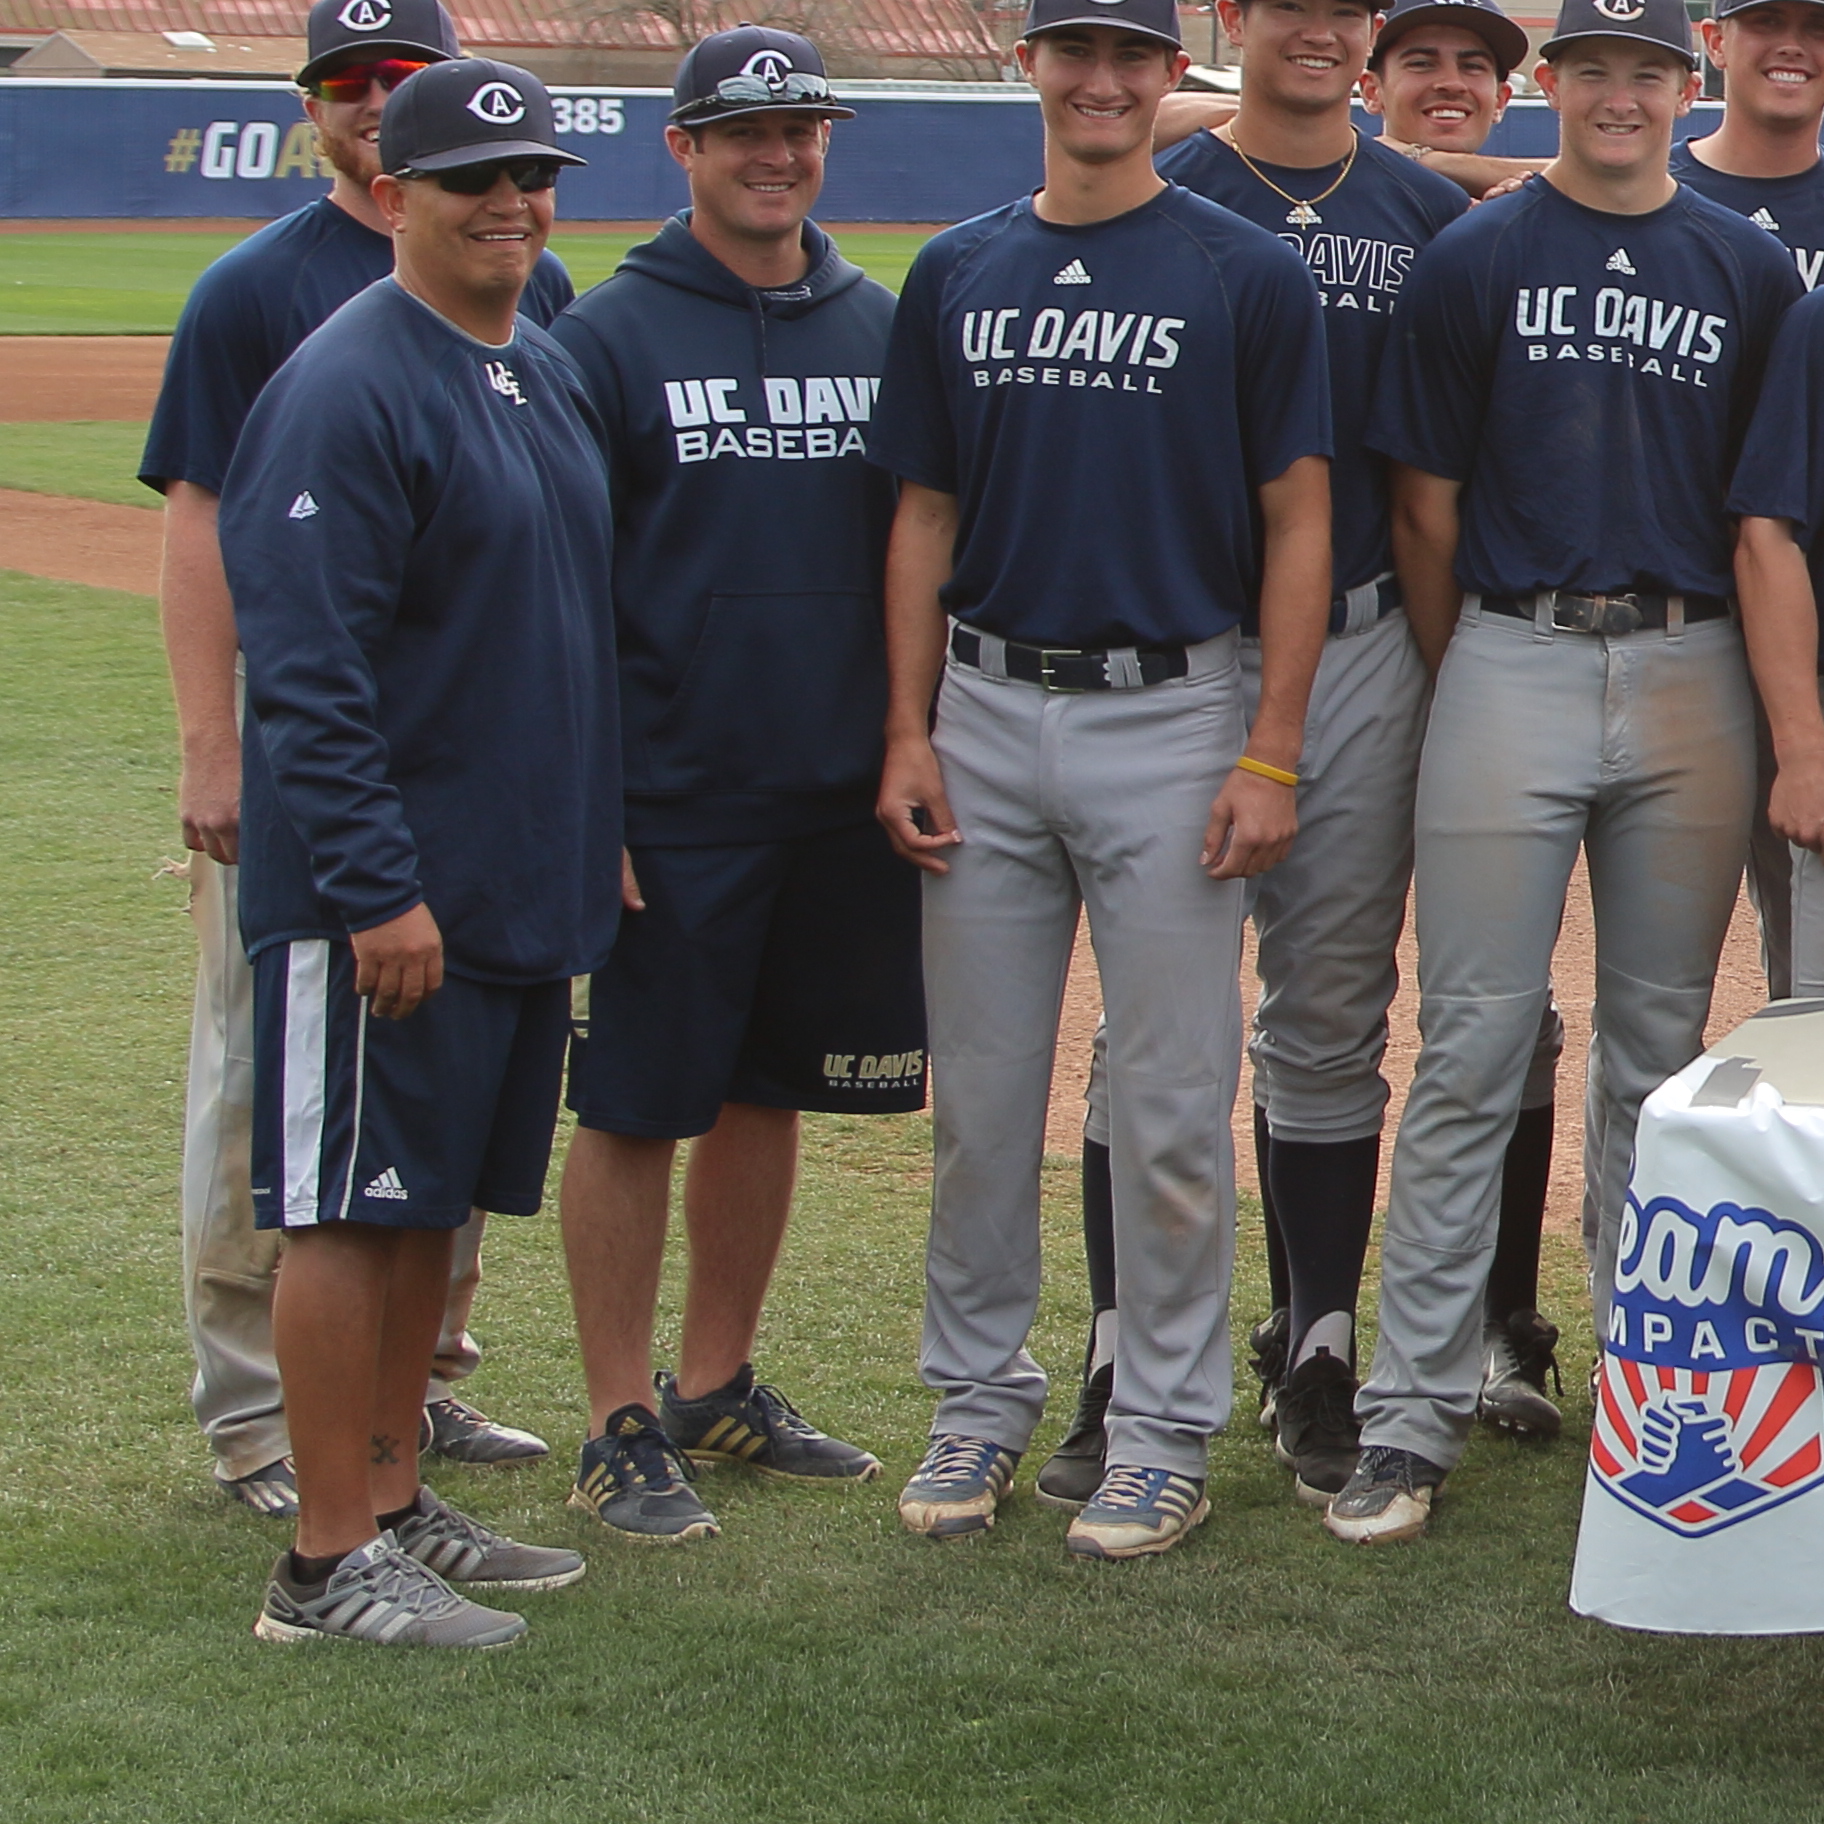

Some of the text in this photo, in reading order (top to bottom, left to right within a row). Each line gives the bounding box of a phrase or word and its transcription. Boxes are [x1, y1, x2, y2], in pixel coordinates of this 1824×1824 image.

[554, 98, 625, 134] 385
[164, 121, 336, 179] #GOA
[1053, 274, 1092, 286] adidas
[962, 308, 1186, 370] UC DAVIS
[1516, 286, 1728, 364] UC DAVIS
[973, 366, 1163, 395] BASEBALL
[664, 378, 746, 428] UC
[824, 1048, 923, 1080] UC DAVIS
[829, 1076, 920, 1090] BASEBALL
[364, 1185, 408, 1201] adidas
